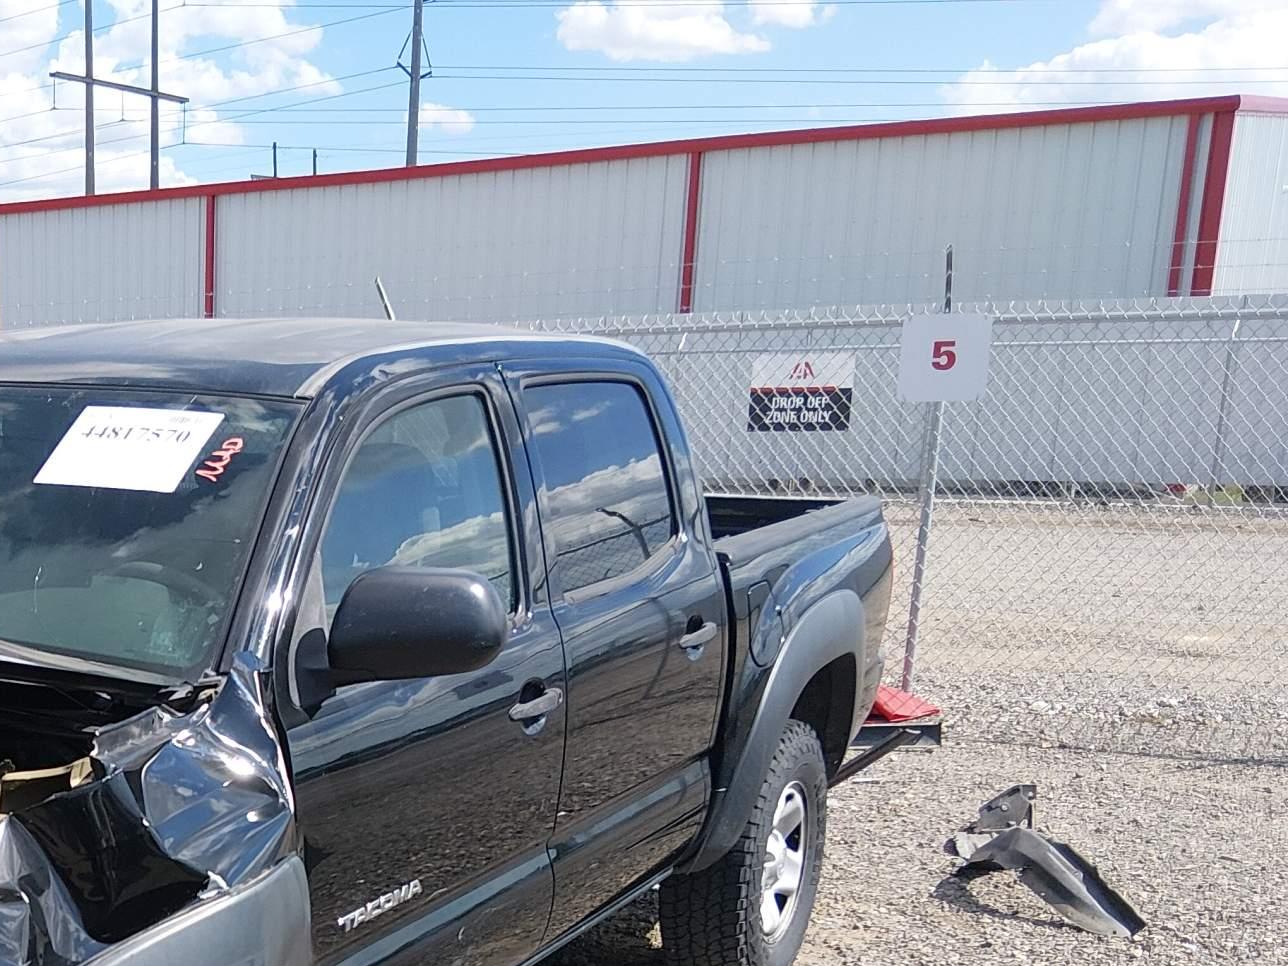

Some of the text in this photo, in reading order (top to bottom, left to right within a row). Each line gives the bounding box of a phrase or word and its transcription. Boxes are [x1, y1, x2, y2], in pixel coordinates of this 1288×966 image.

[931, 341, 956, 370] 5
[771, 396, 829, 409] DROP OFF
[765, 410, 833, 424] ZONE ONLY
[82, 425, 191, 443] 44817570
[337, 878, 423, 933] TACOMA
